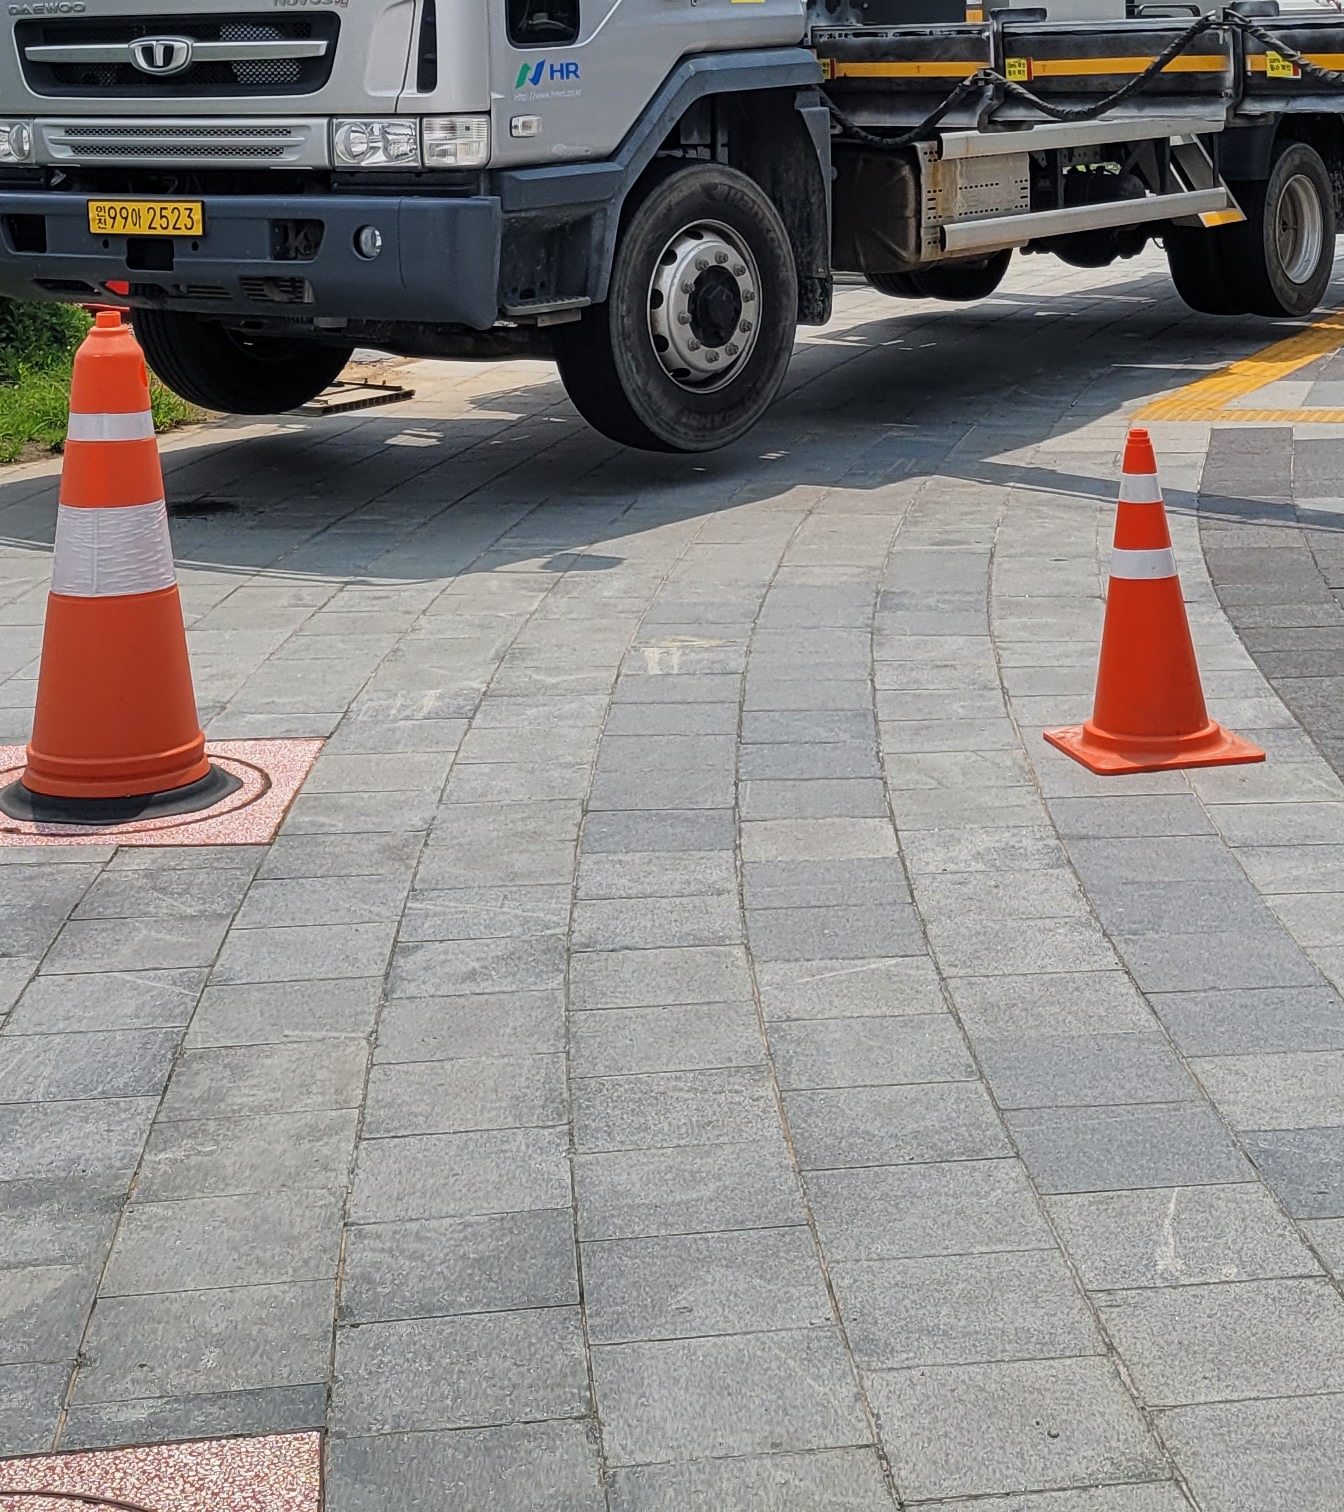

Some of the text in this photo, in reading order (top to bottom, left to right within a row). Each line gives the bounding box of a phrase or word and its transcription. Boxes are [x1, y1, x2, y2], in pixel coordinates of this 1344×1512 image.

[7, 1, 87, 17] DAEWOO
[95, 205, 107, 230] 인천
[146, 206, 195, 231] 2523
